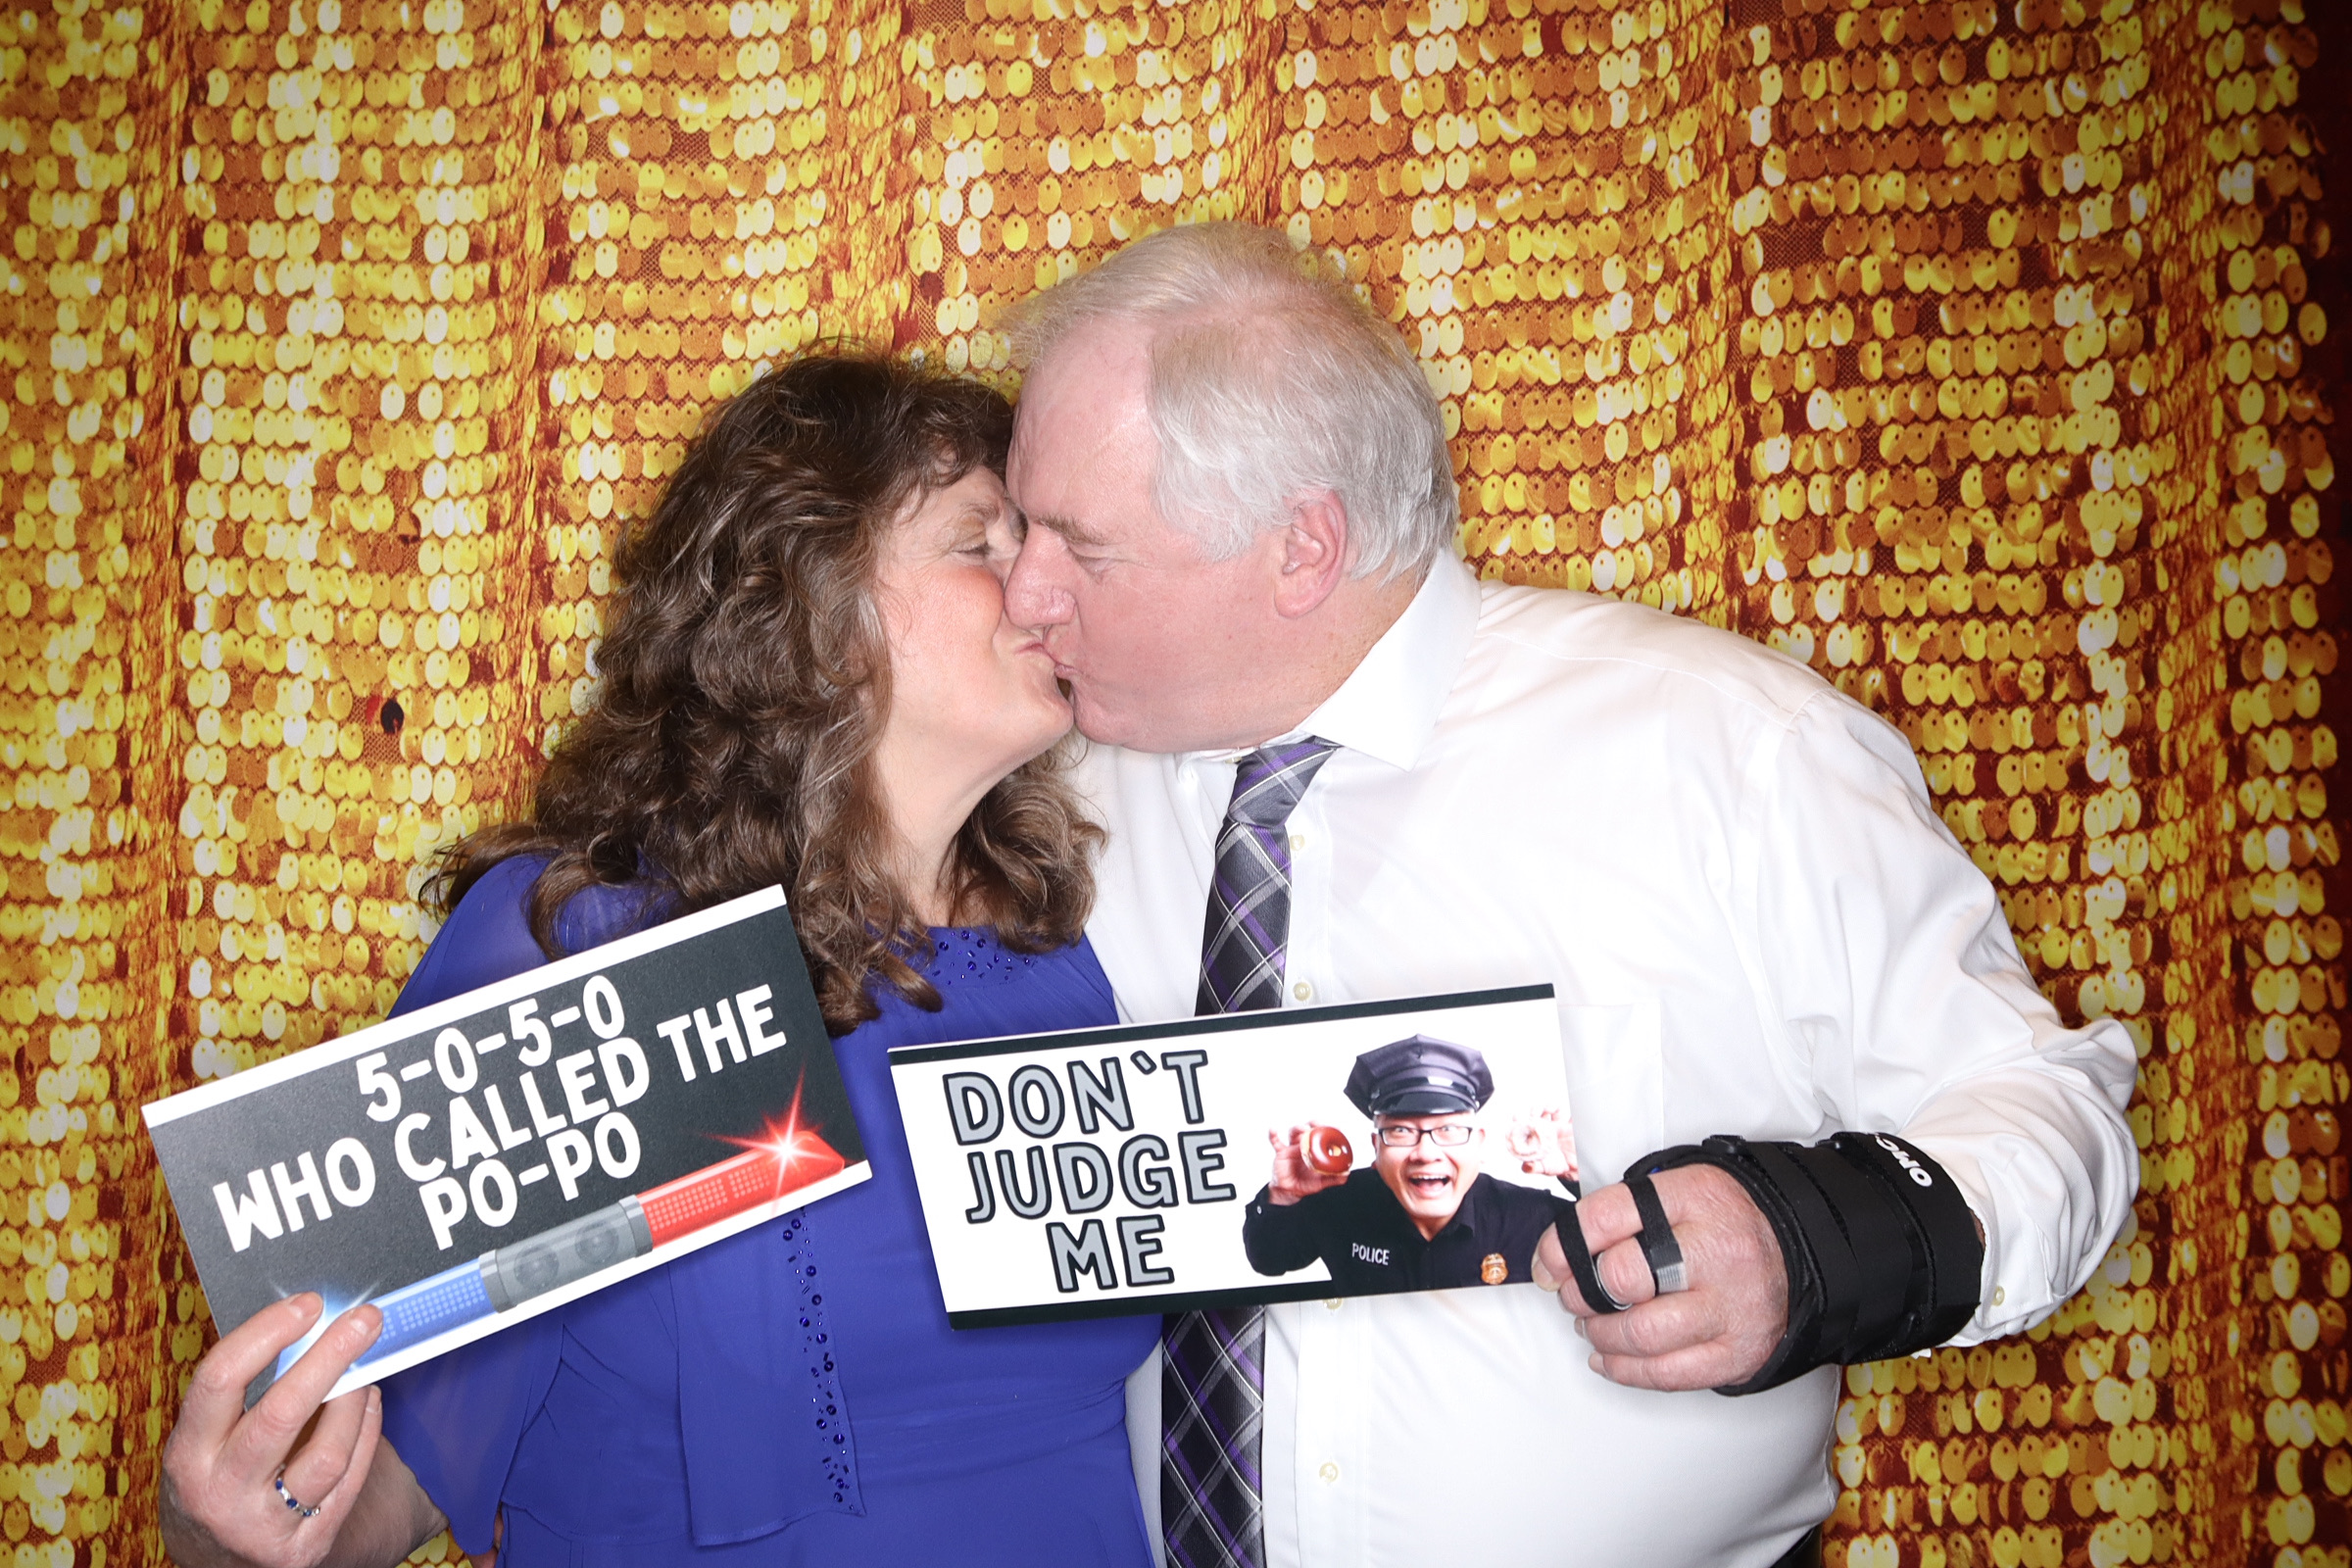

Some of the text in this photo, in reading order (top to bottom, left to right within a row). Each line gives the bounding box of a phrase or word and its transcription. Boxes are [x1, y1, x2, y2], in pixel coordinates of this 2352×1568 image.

[355, 974, 625, 1122] 5-0-5-0
[212, 983, 787, 1253] WHO CALLED THE
[964, 1128, 1237, 1225] JUDGE
[418, 1111, 642, 1251] PO-PO
[1045, 1213, 1175, 1294] ME
[1351, 1242, 1391, 1266] POLICE
